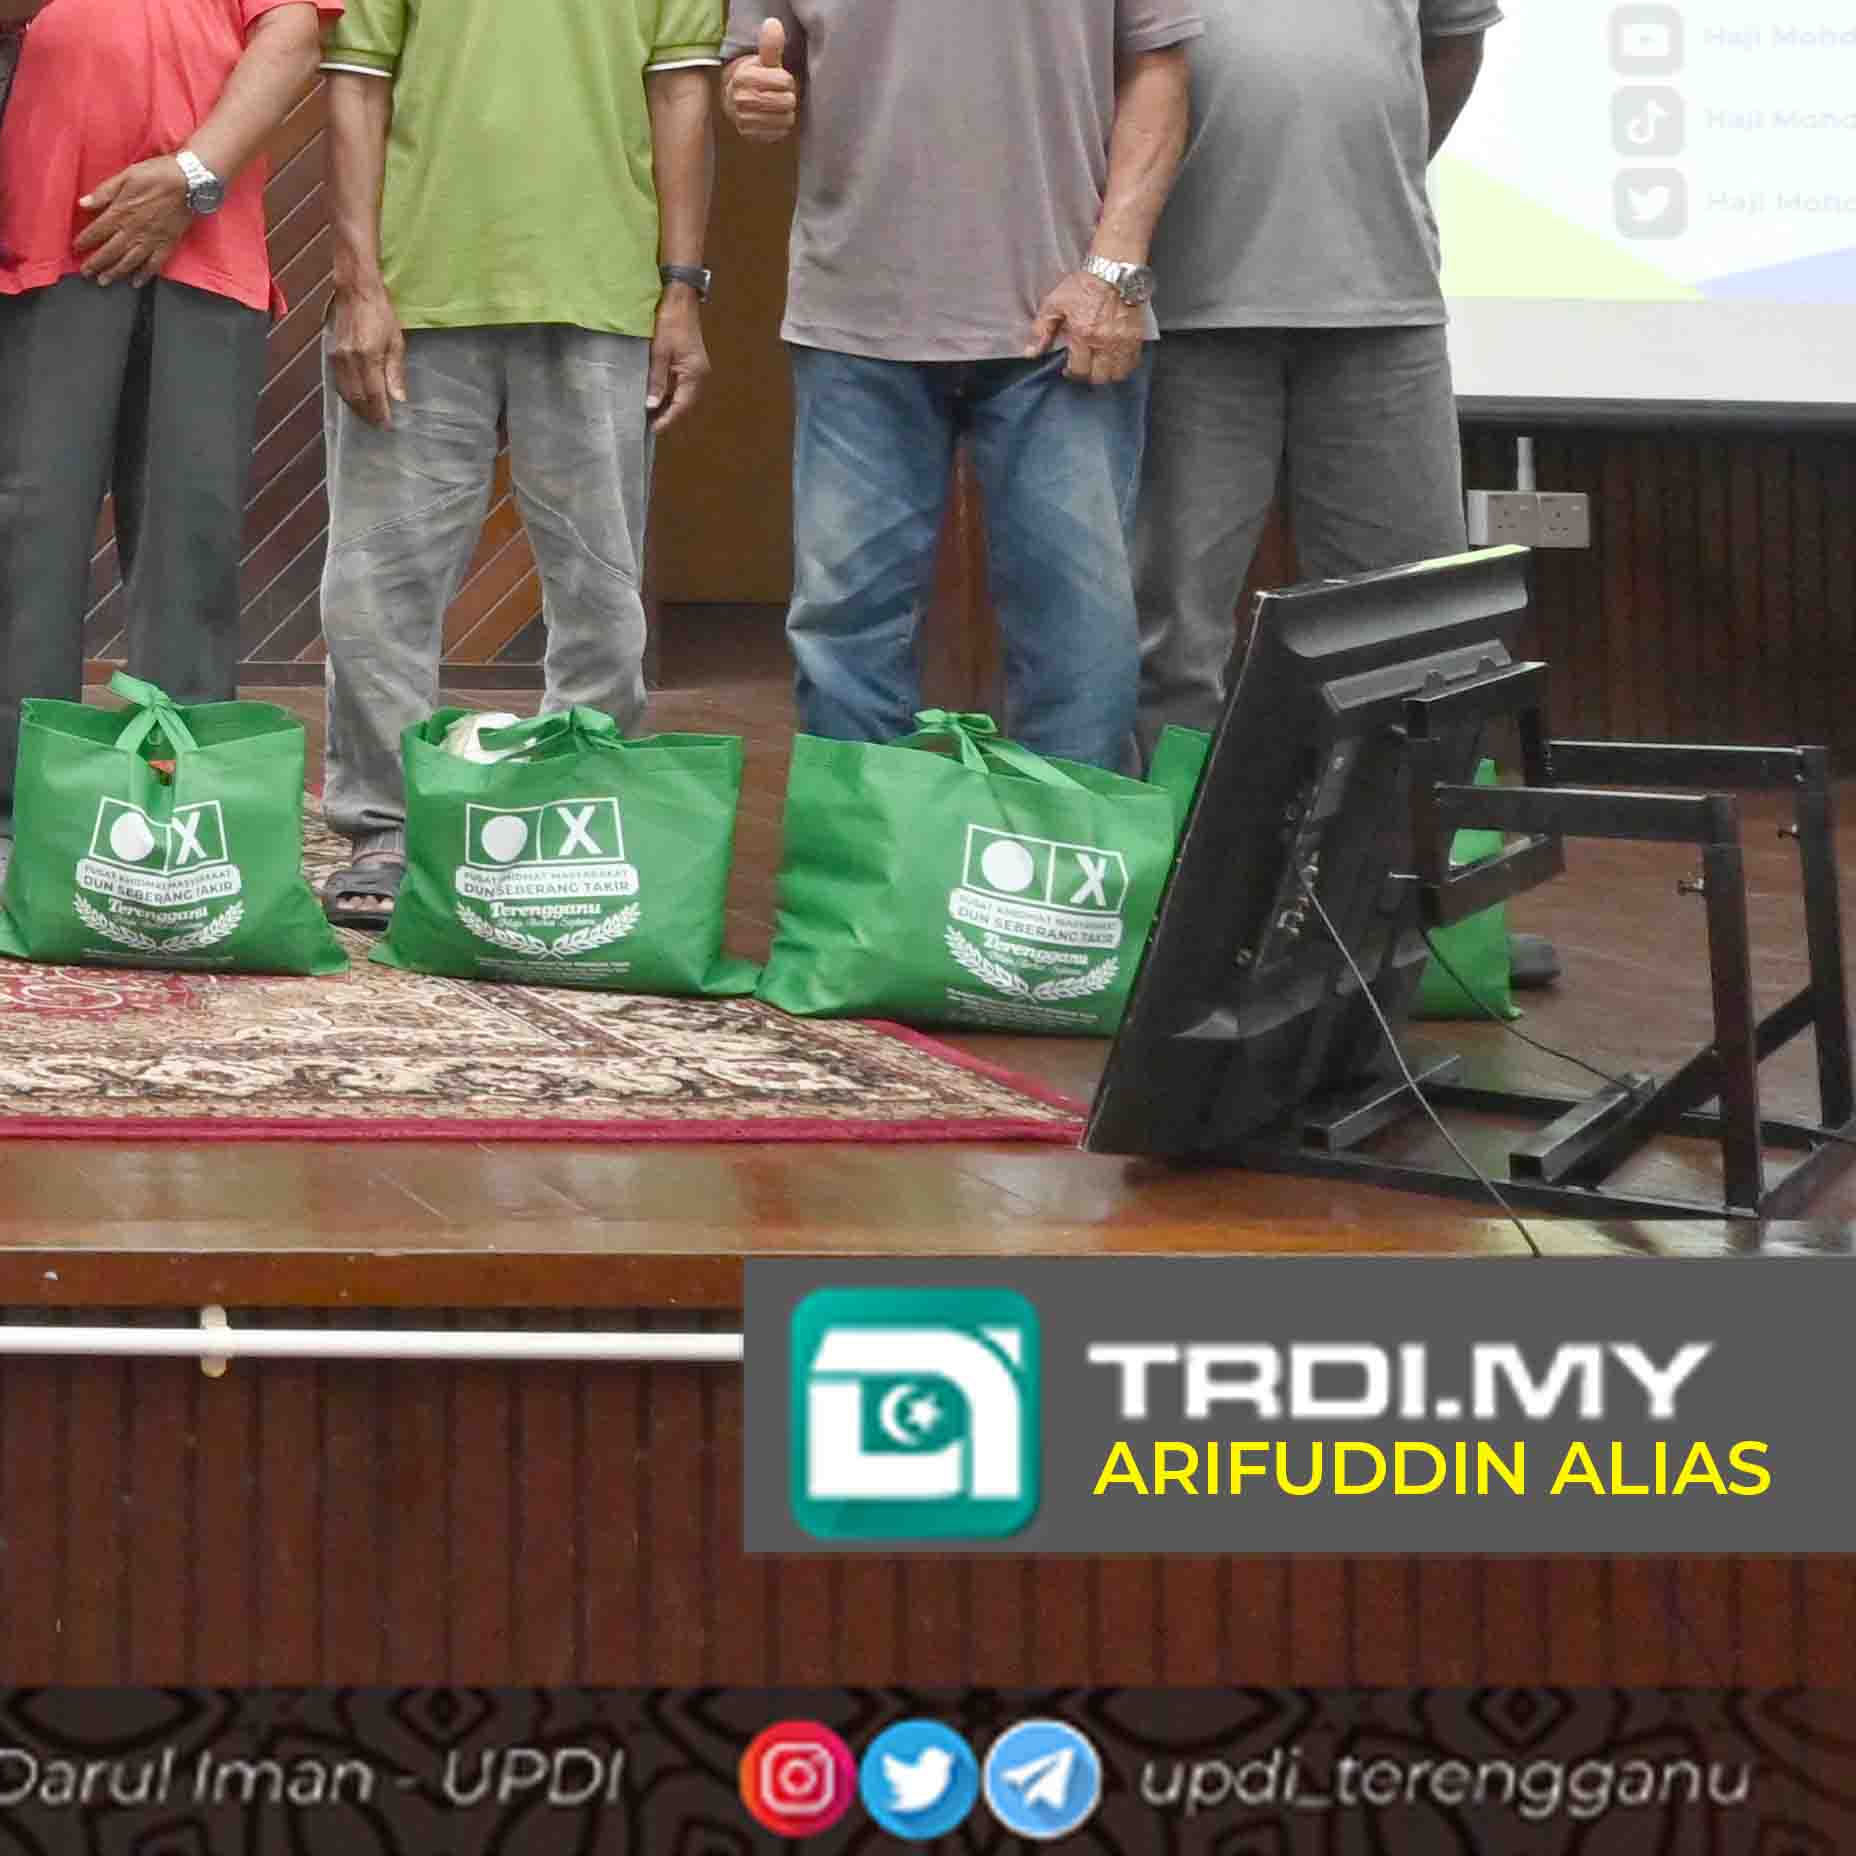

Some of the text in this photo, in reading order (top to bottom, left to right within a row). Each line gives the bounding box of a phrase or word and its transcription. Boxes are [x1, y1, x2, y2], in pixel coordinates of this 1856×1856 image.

[83, 875, 113, 891] DUN
[464, 881, 631, 897] DUN SEBERANG TAKIR
[489, 901, 601, 921] Terengganu
